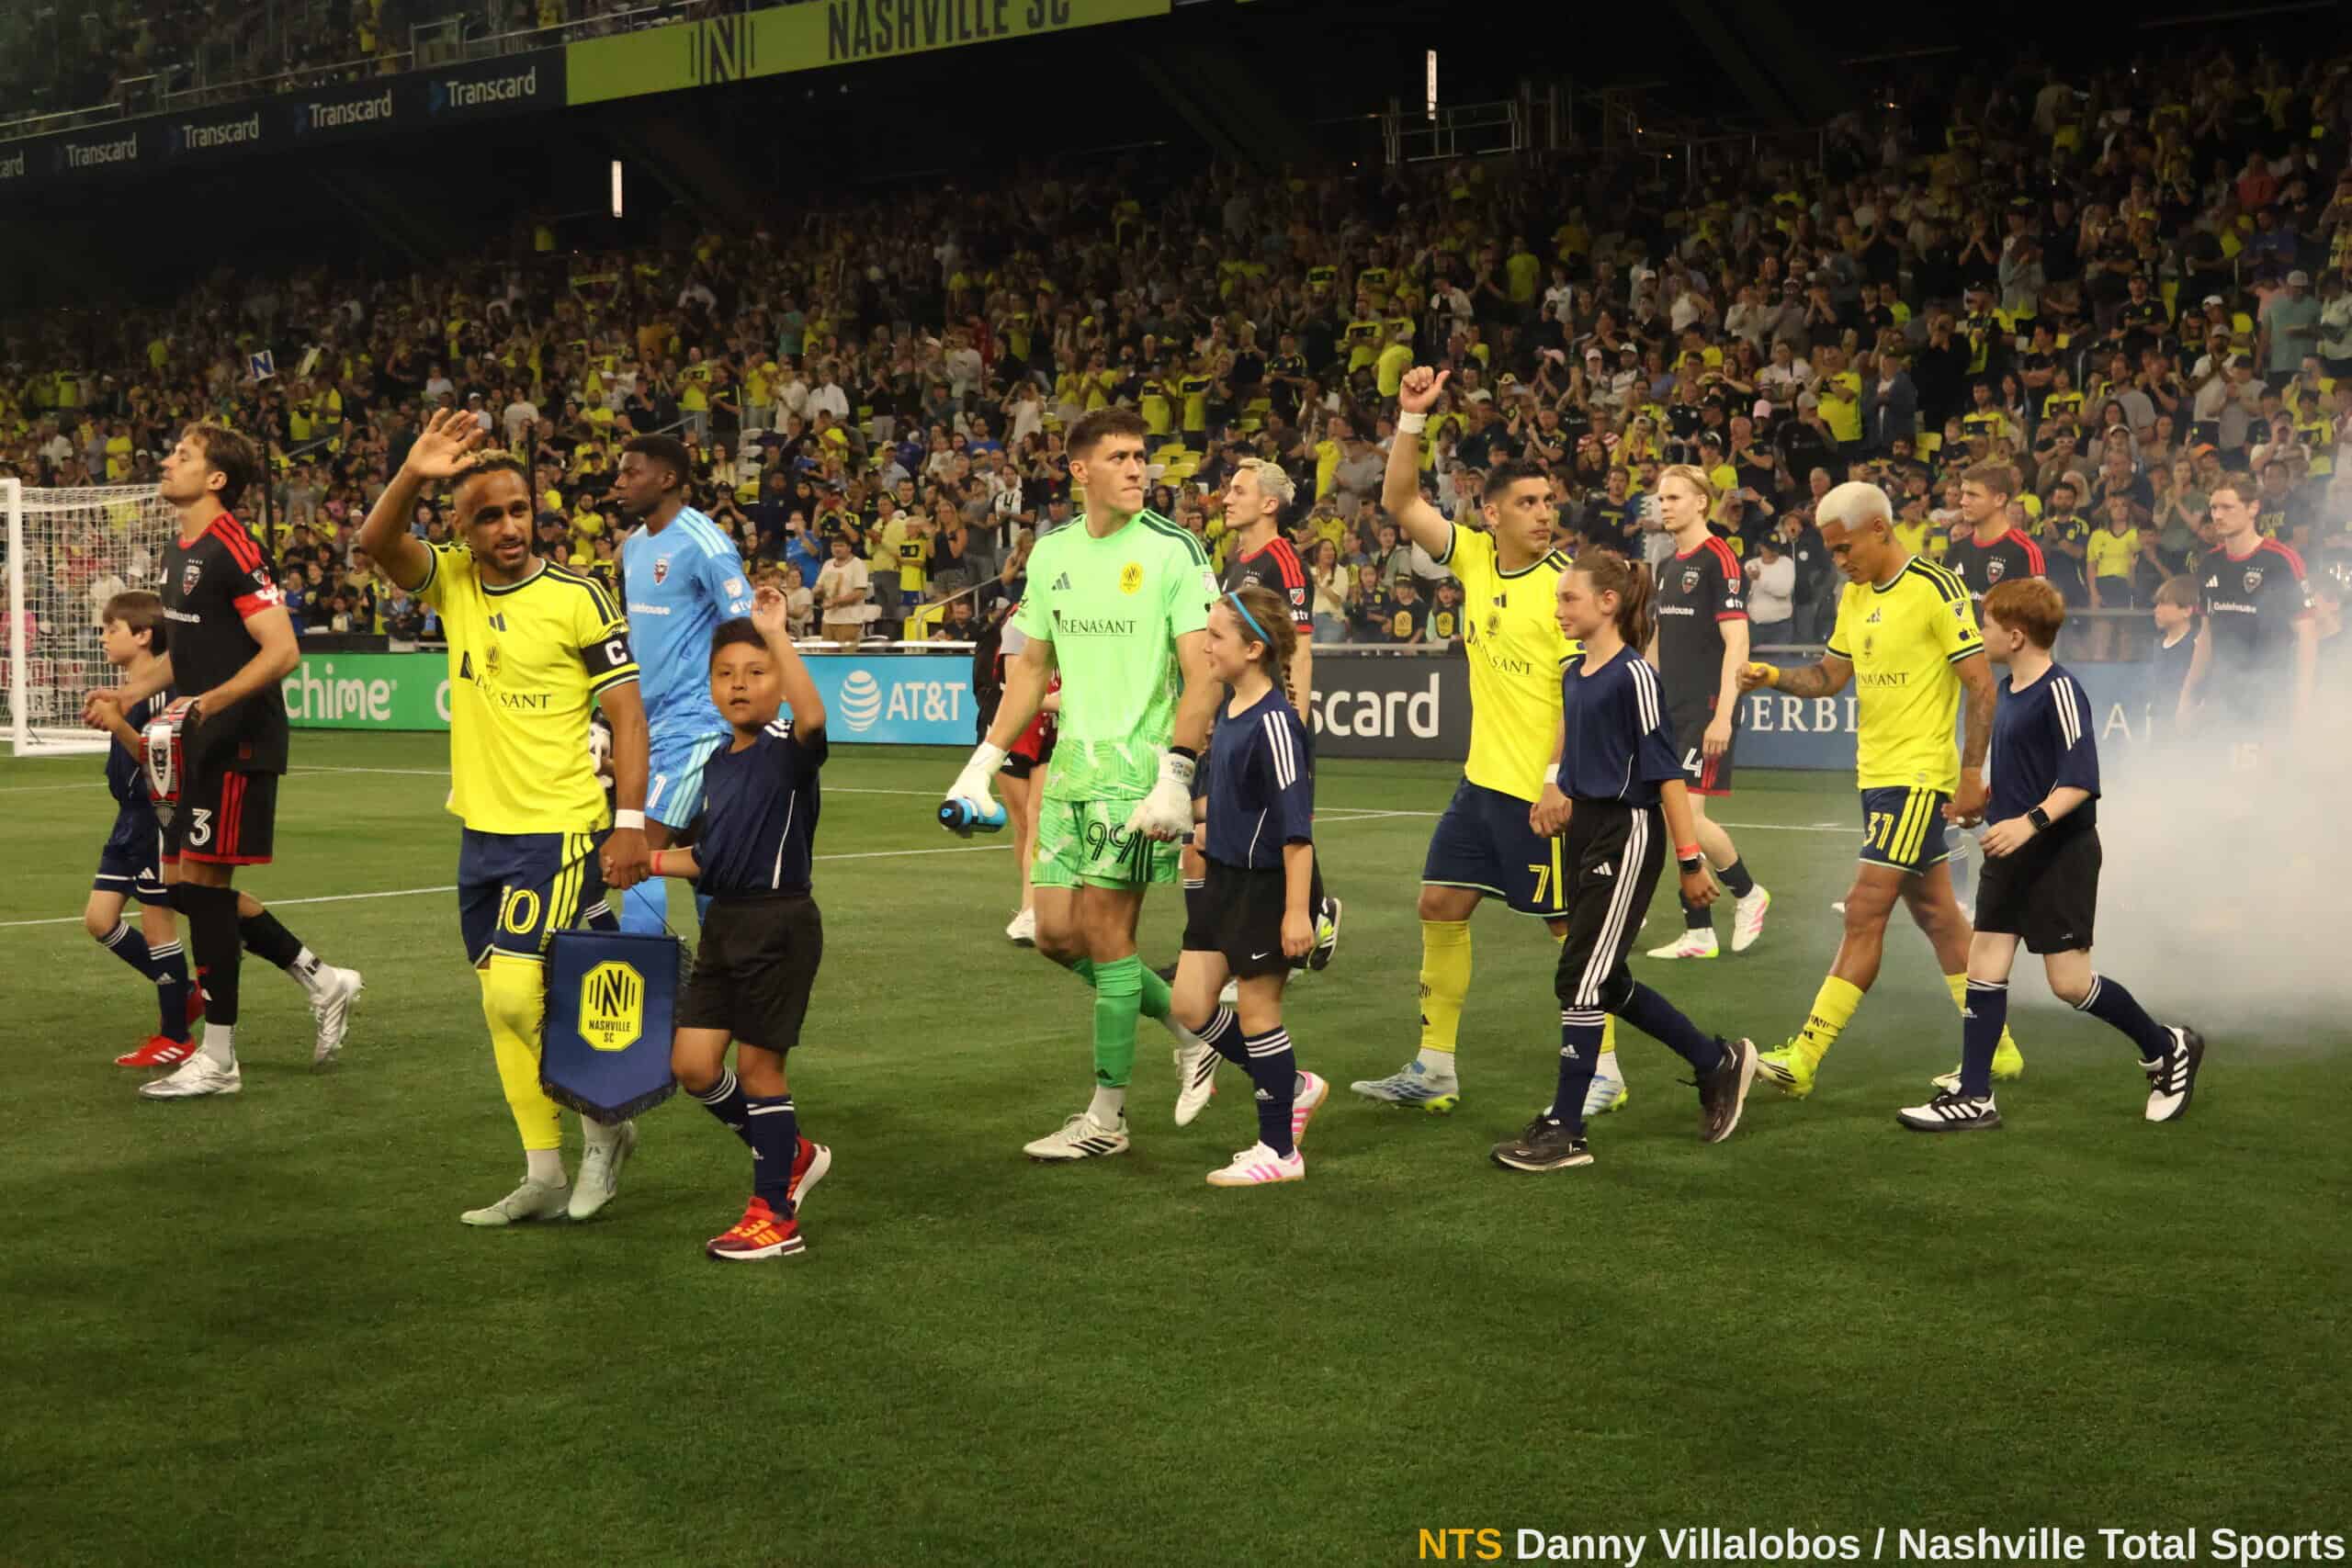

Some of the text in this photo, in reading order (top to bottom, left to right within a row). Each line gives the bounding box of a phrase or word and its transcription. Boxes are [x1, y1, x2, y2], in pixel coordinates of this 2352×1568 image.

[829, 0, 1009, 60] NASHVILLE
[447, 65, 537, 107] Transcard
[310, 88, 392, 129] Transcard
[184, 111, 259, 149] Transcard
[66, 131, 137, 168] Transcard
[251, 352, 274, 378] N
[1062, 617, 1136, 635] RENASANT
[605, 639, 628, 666] C
[281, 661, 390, 720] chime
[887, 682, 967, 721] AT&T
[1682, 748, 1703, 778] 4
[647, 773, 667, 808] 1
[189, 807, 212, 846] 3
[1087, 820, 1137, 863] 99
[1528, 863, 1551, 903] 7
[496, 885, 540, 934] 10
[588, 1020, 631, 1032] NASHVILLE
[603, 1032, 615, 1043] SC
